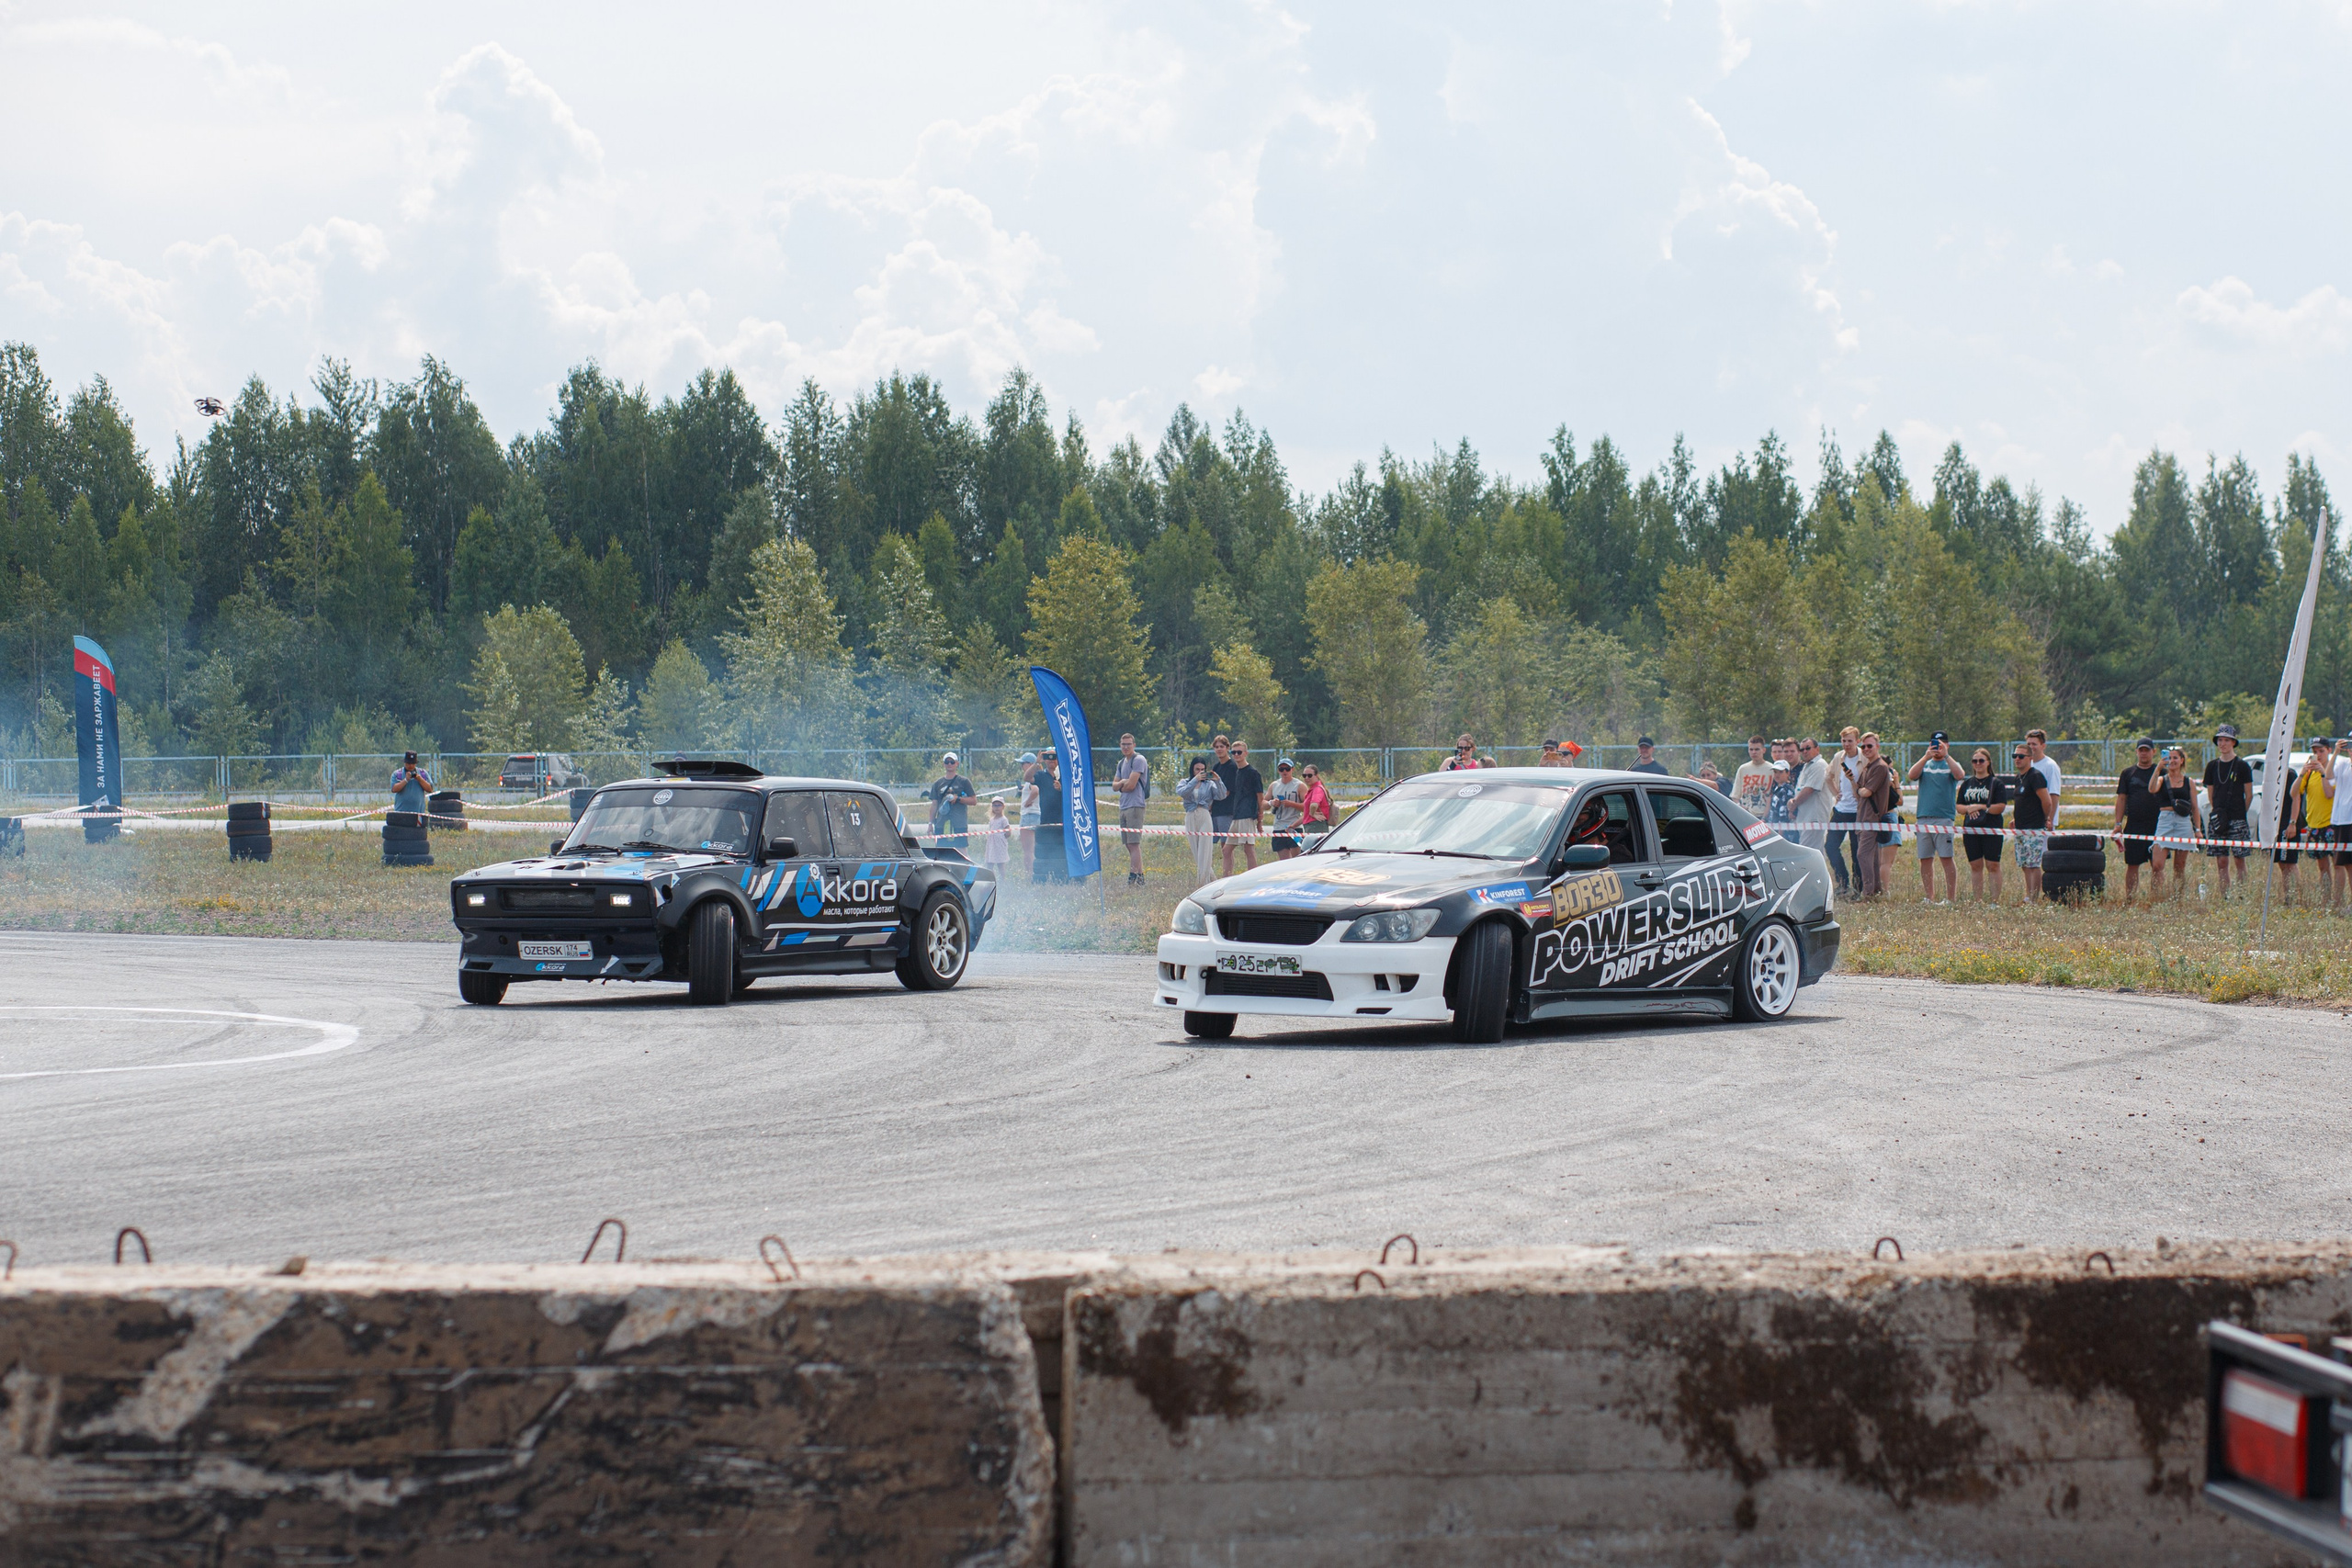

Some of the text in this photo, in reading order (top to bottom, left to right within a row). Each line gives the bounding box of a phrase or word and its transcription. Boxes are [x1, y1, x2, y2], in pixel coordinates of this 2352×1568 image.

[92, 665, 103, 726] ЗАРЖАВЕЕТ
[96, 728, 104, 741] НЕ
[96, 744, 105, 773] НАМИ
[97, 775, 106, 787] ЗА
[850, 813, 861, 826] 13
[1746, 821, 1769, 840] MOTUL
[797, 874, 897, 903] Akkora
[1490, 888, 1525, 898] KINFOREST
[823, 904, 895, 917] масла, которые работают
[1529, 855, 1768, 987] POWERSLIDE
[524, 945, 563, 955] OZERSK
[1599, 919, 1739, 987] DRIFT SCHOOL
